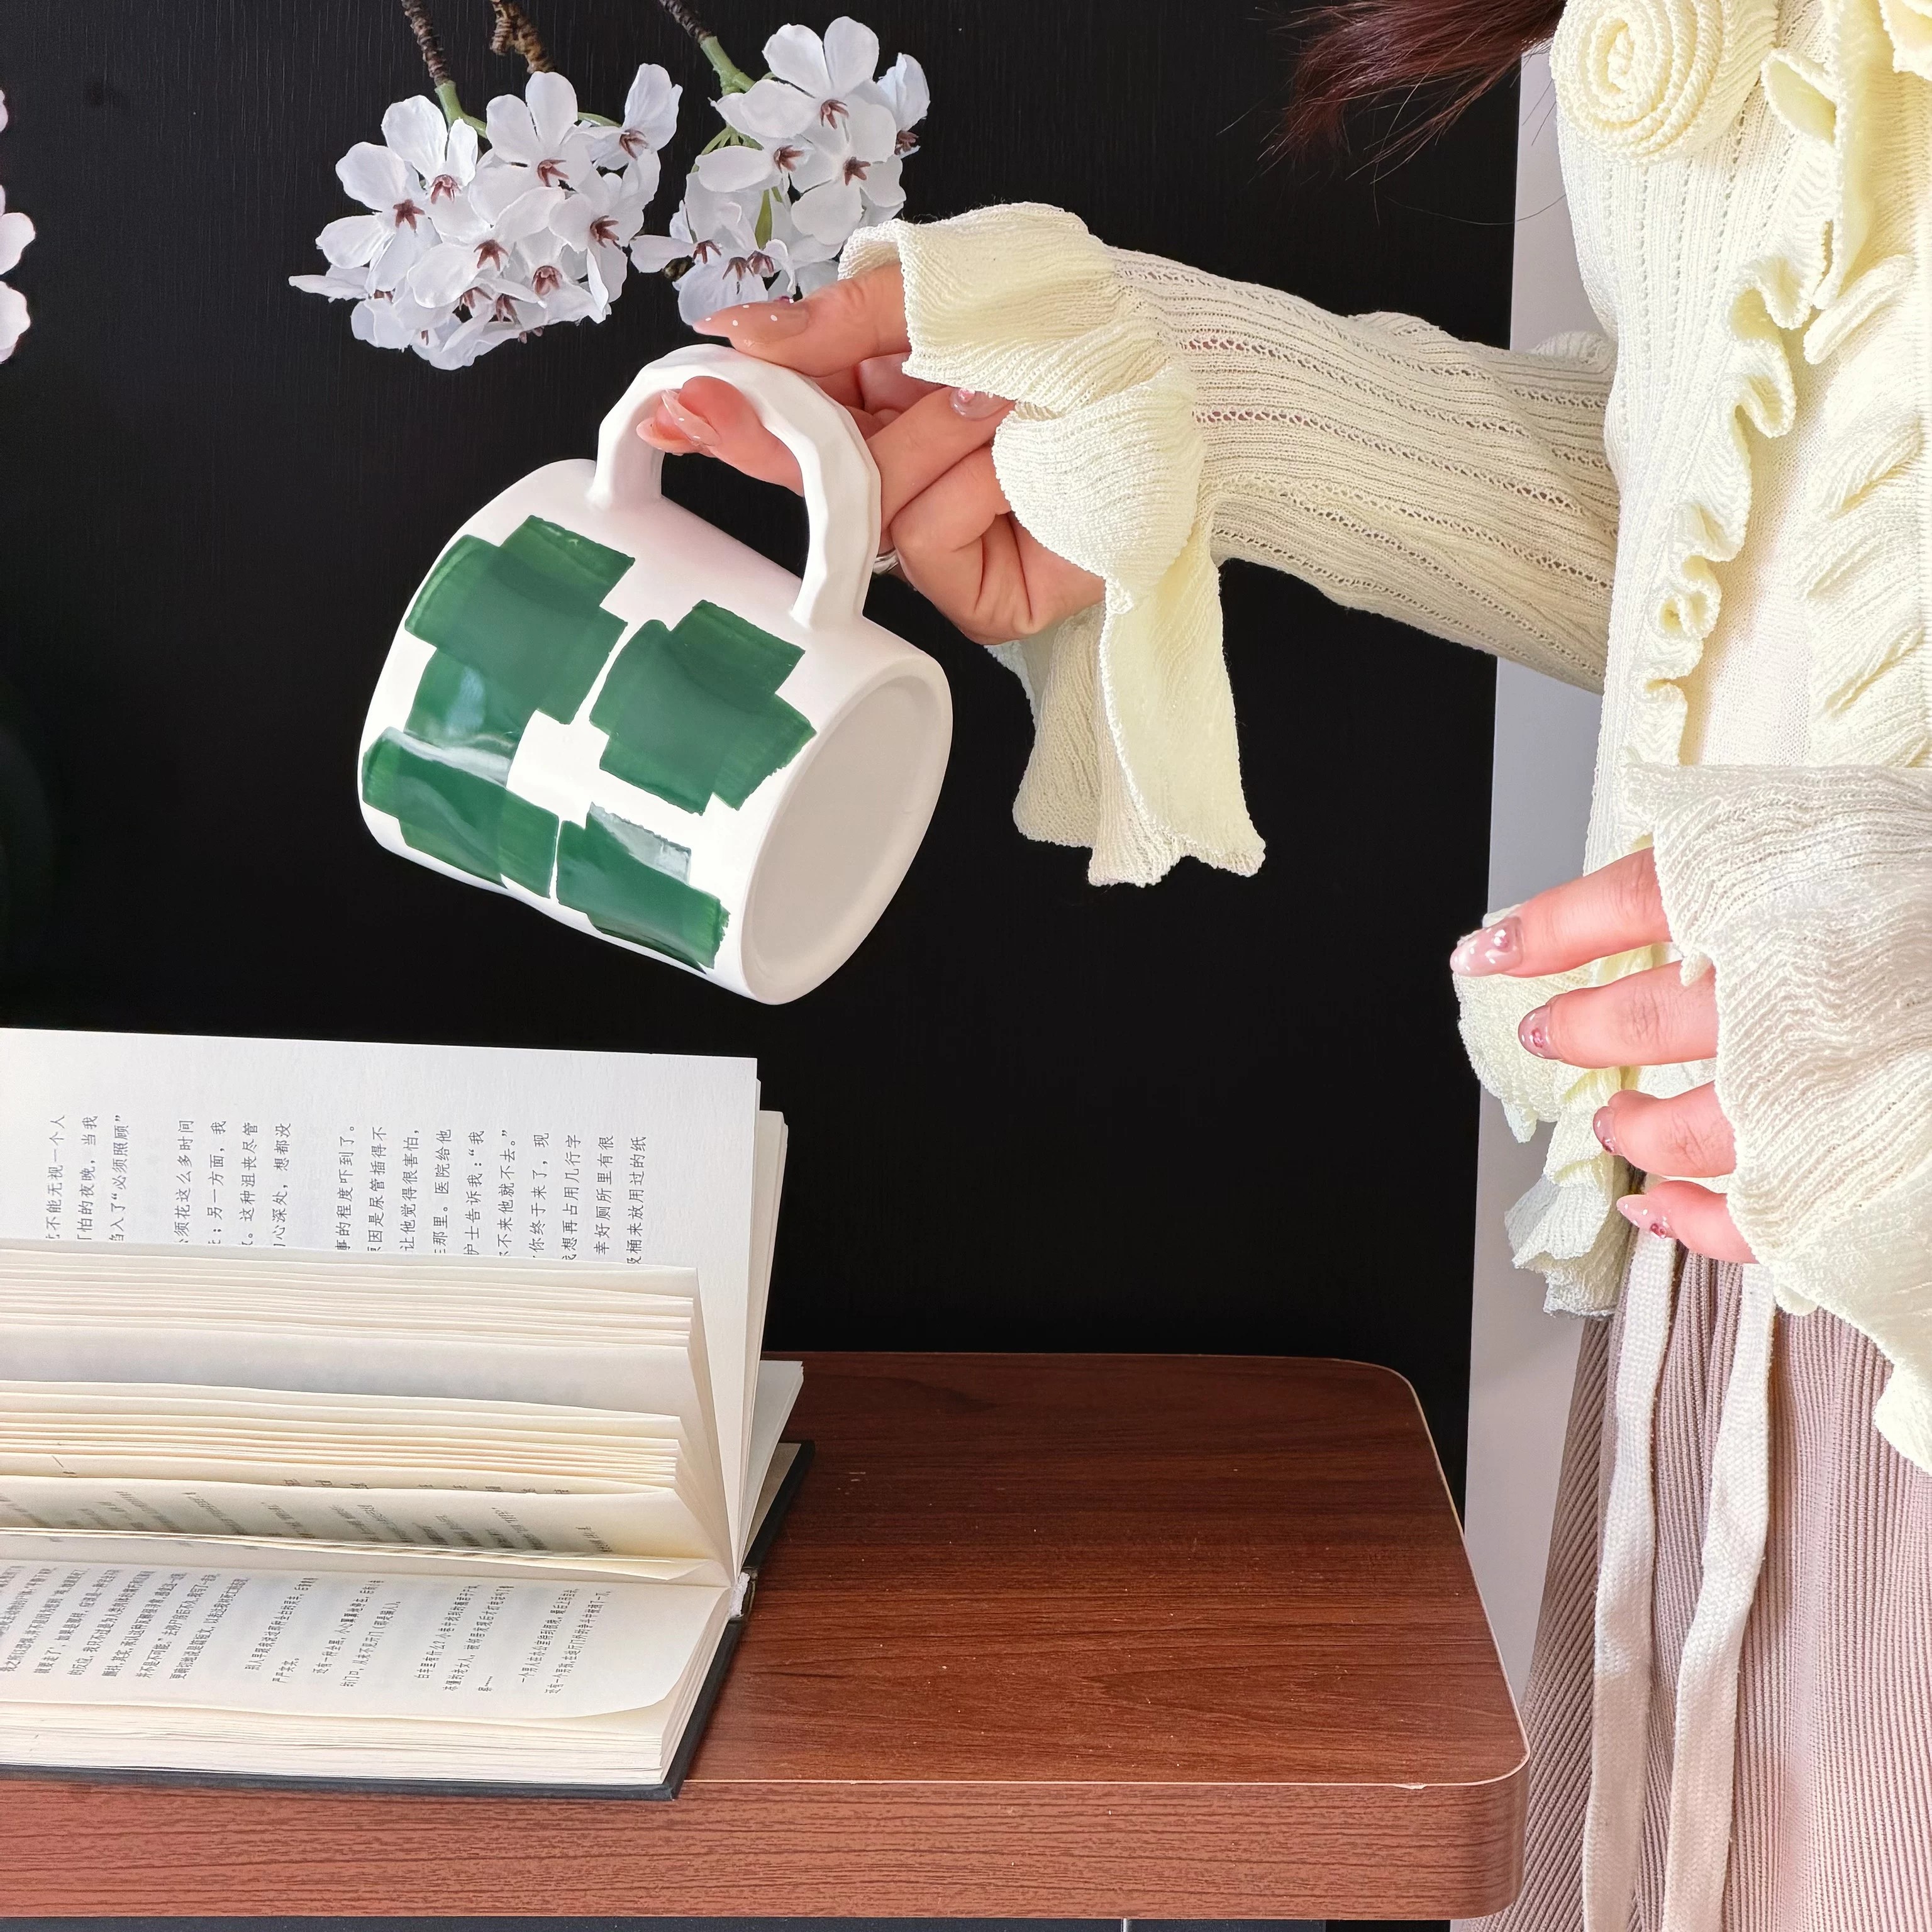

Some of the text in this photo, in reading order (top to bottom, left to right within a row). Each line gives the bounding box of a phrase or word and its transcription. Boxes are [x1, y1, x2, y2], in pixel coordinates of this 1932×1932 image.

[46, 1115, 65, 1240] 不能无视一个人
[174, 1120, 194, 1243] 须花这么多时间
[207, 1121, 227, 1245] ；另一方面，我
[239, 1122, 258, 1246] 。这种沮丧尽管
[272, 1123, 291, 1247] 心深处，想都没
[335, 1126, 355, 1251] 事的程度吓到了。
[399, 1130, 419, 1252] 让他觉得很害怕，
[433, 1129, 452, 1253] 那里。医院给他
[497, 1130, 516, 1256] 不来他就不去。”
[594, 1135, 614, 1255] 幸好厕所里有很
